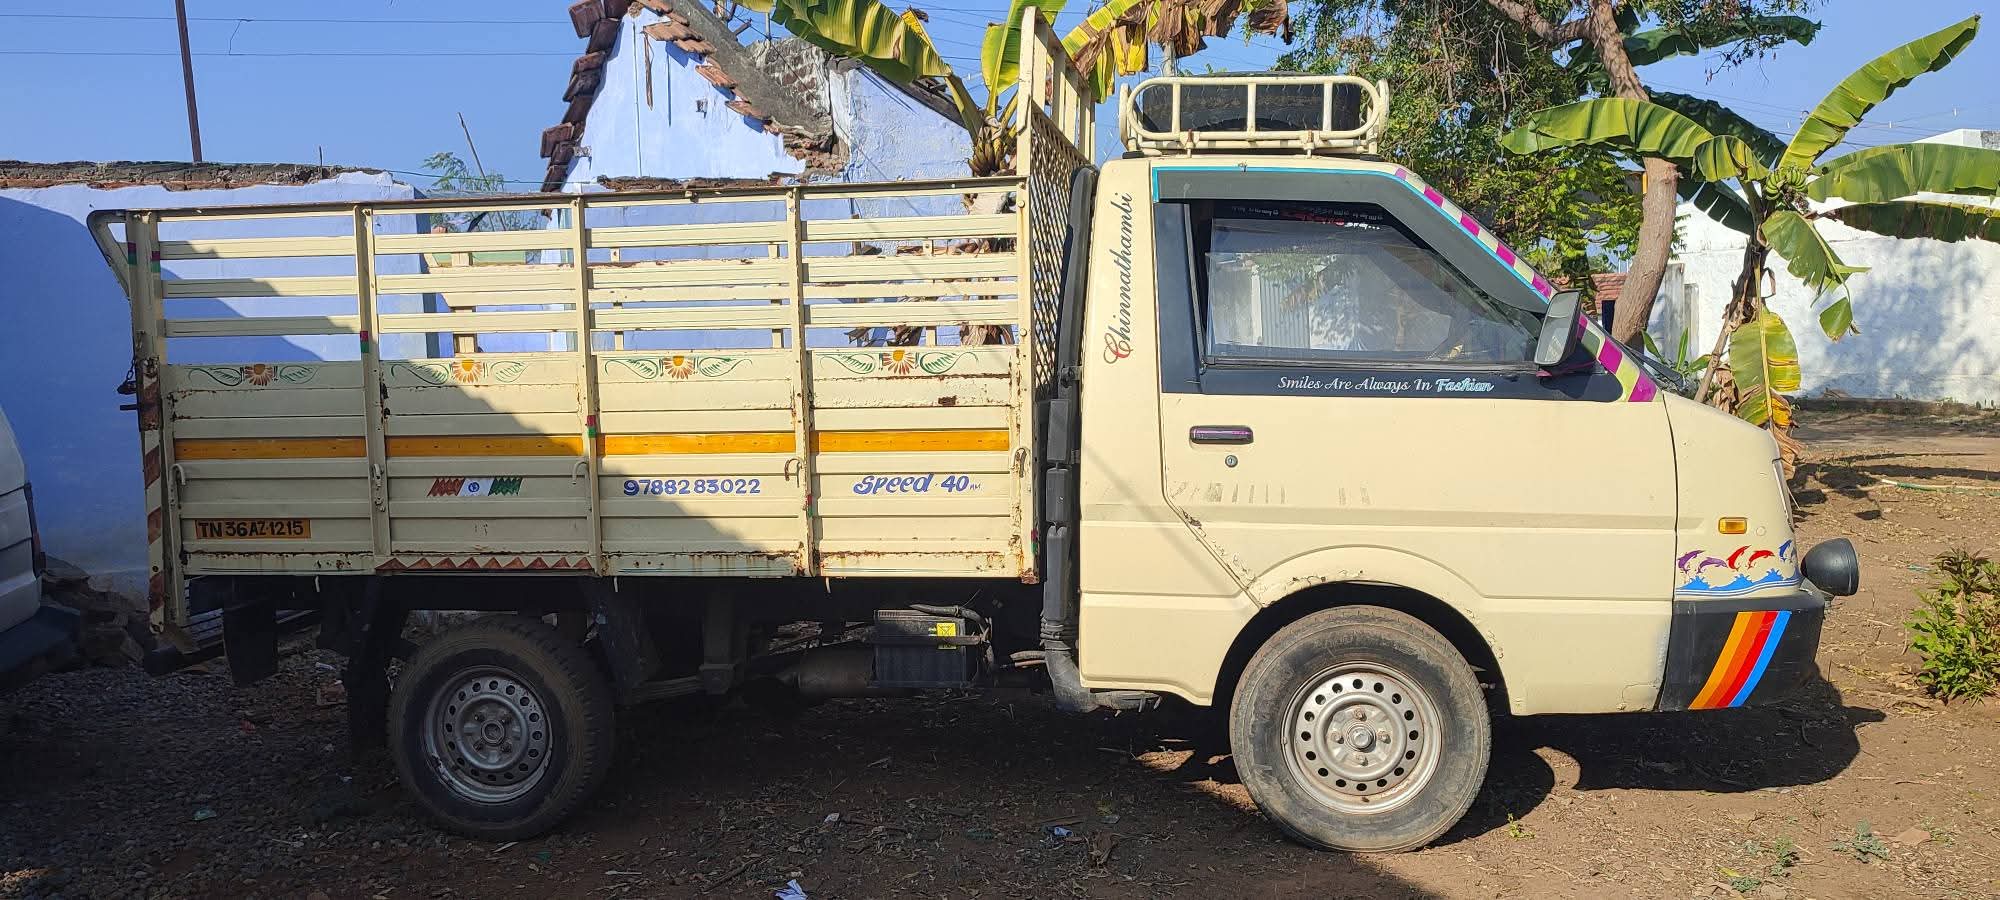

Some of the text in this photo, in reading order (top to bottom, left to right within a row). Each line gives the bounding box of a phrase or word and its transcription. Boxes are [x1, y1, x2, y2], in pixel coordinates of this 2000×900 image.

[1103, 192, 1133, 364] Chinnathambi
[1277, 376, 1494, 394] Smiles Are Always In Fashion
[853, 473, 934, 495] Speed
